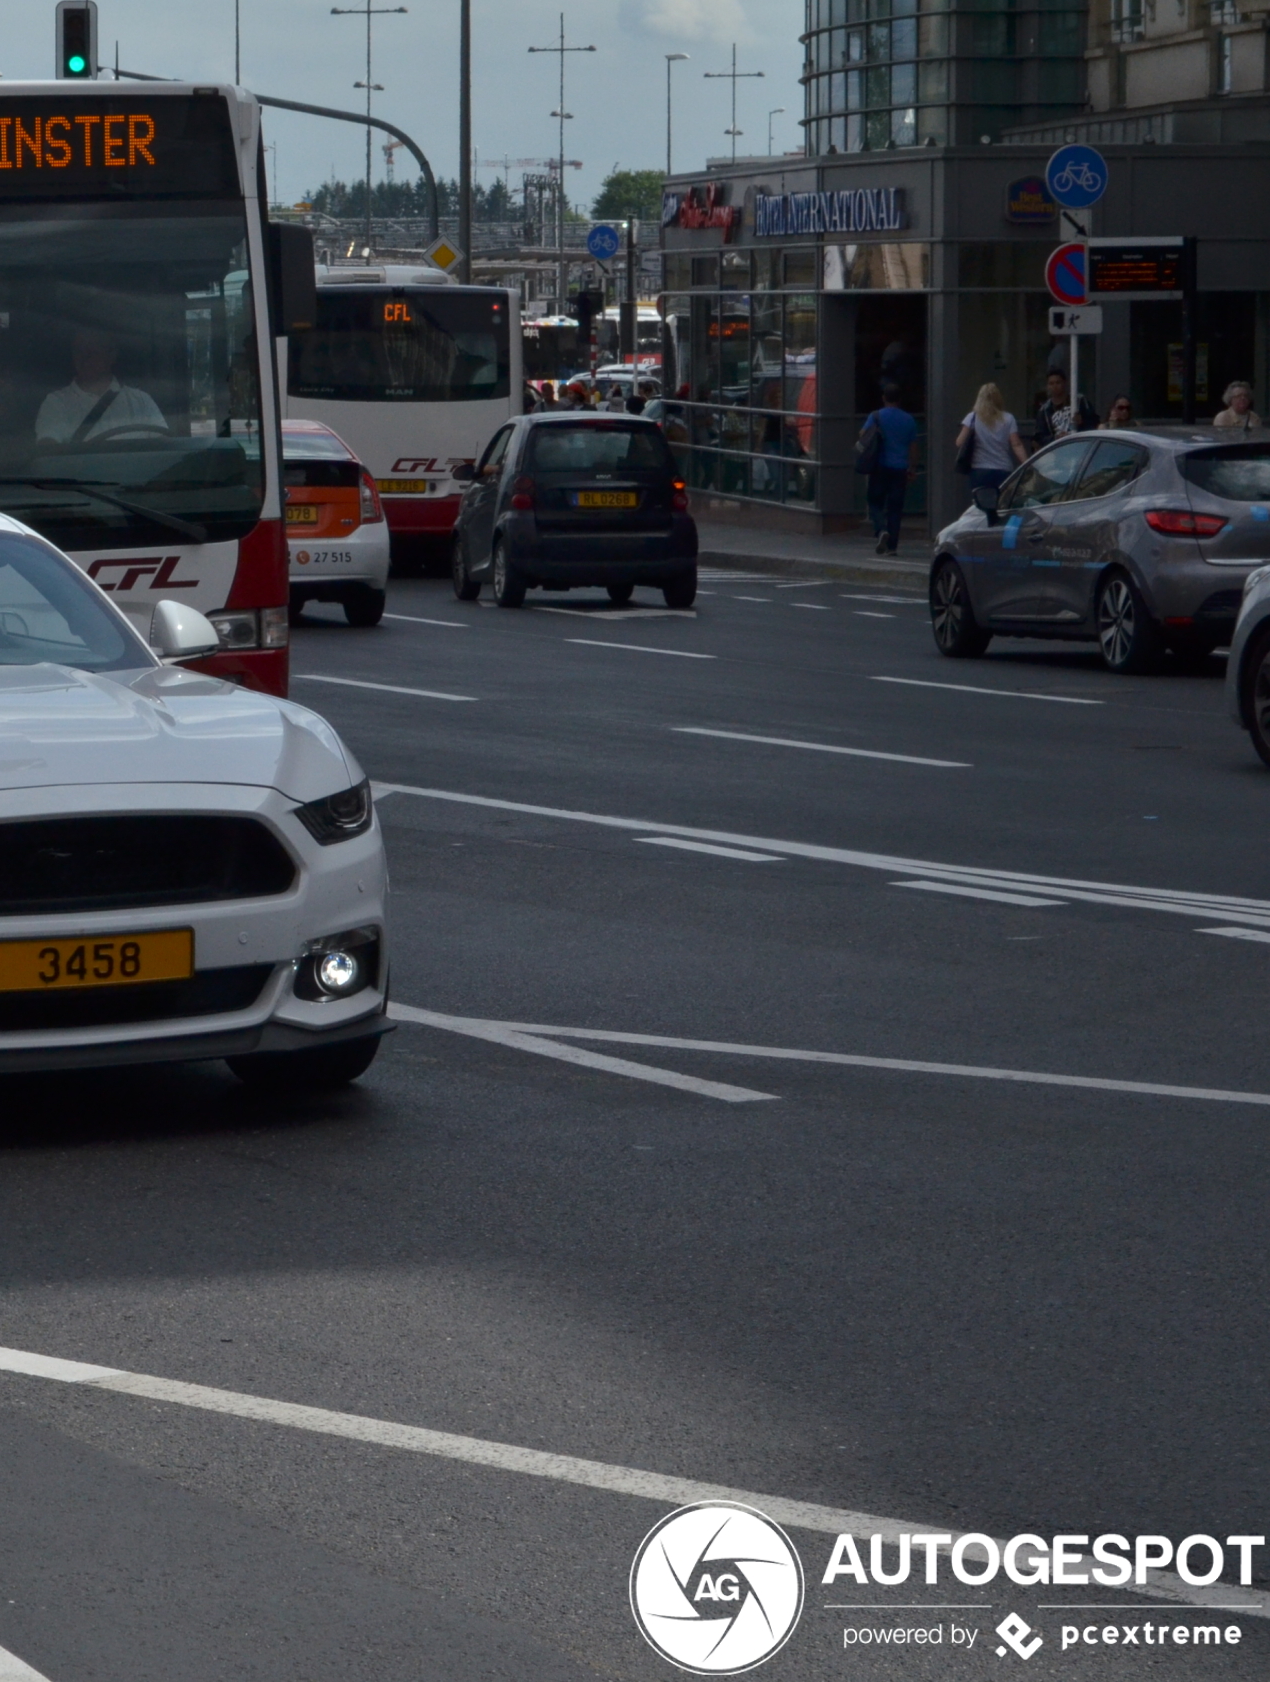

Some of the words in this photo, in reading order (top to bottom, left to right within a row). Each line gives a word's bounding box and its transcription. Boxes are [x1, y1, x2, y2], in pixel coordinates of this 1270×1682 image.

[756, 194, 785, 236] HOTEL
[787, 187, 900, 234] INTERNATIONAL
[384, 304, 411, 321] CFL
[385, 388, 414, 396] MAN
[391, 458, 446, 473] CFL
[584, 494, 598, 504] RL
[314, 552, 329, 563] 27
[332, 552, 352, 563] 515
[86, 556, 200, 591] CFL
[38, 942, 141, 983] 3458
